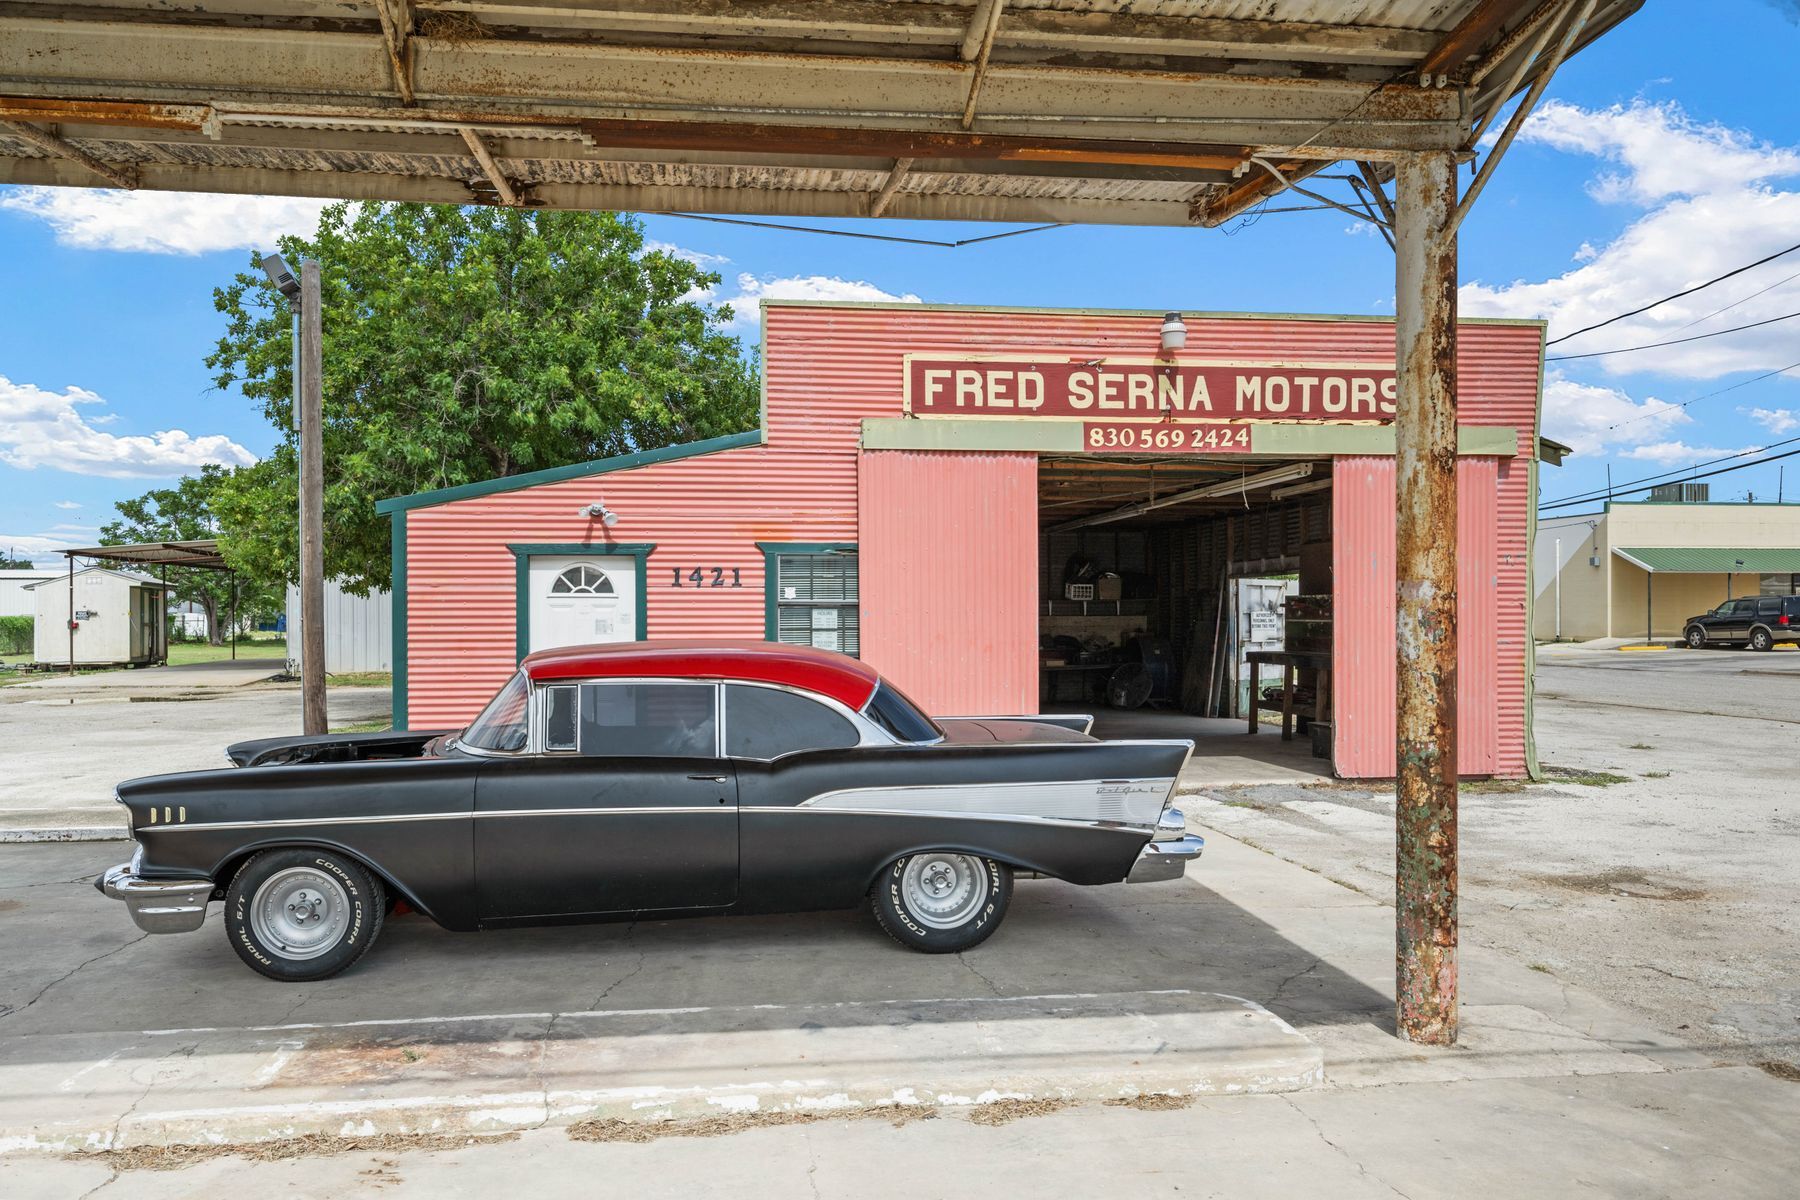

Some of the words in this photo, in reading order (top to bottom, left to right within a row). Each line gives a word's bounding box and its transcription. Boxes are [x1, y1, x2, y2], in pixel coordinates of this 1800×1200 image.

[924, 369, 1045, 408] FRED
[1067, 371, 1213, 411] SERNA
[1235, 375, 1397, 414] MOTORS
[1089, 428, 1135, 447] 830
[1139, 429, 1185, 448] 569
[1191, 428, 1249, 449] 2424
[671, 566, 742, 588] 1421
[987, 859, 1000, 896] DIAL
[236, 894, 246, 920] G/T
[315, 858, 358, 896] COOPER
[347, 901, 362, 945] COBRA
[891, 884, 927, 937] COOPER
[976, 903, 995, 929] G/T
[239, 926, 272, 966] RADIAL
